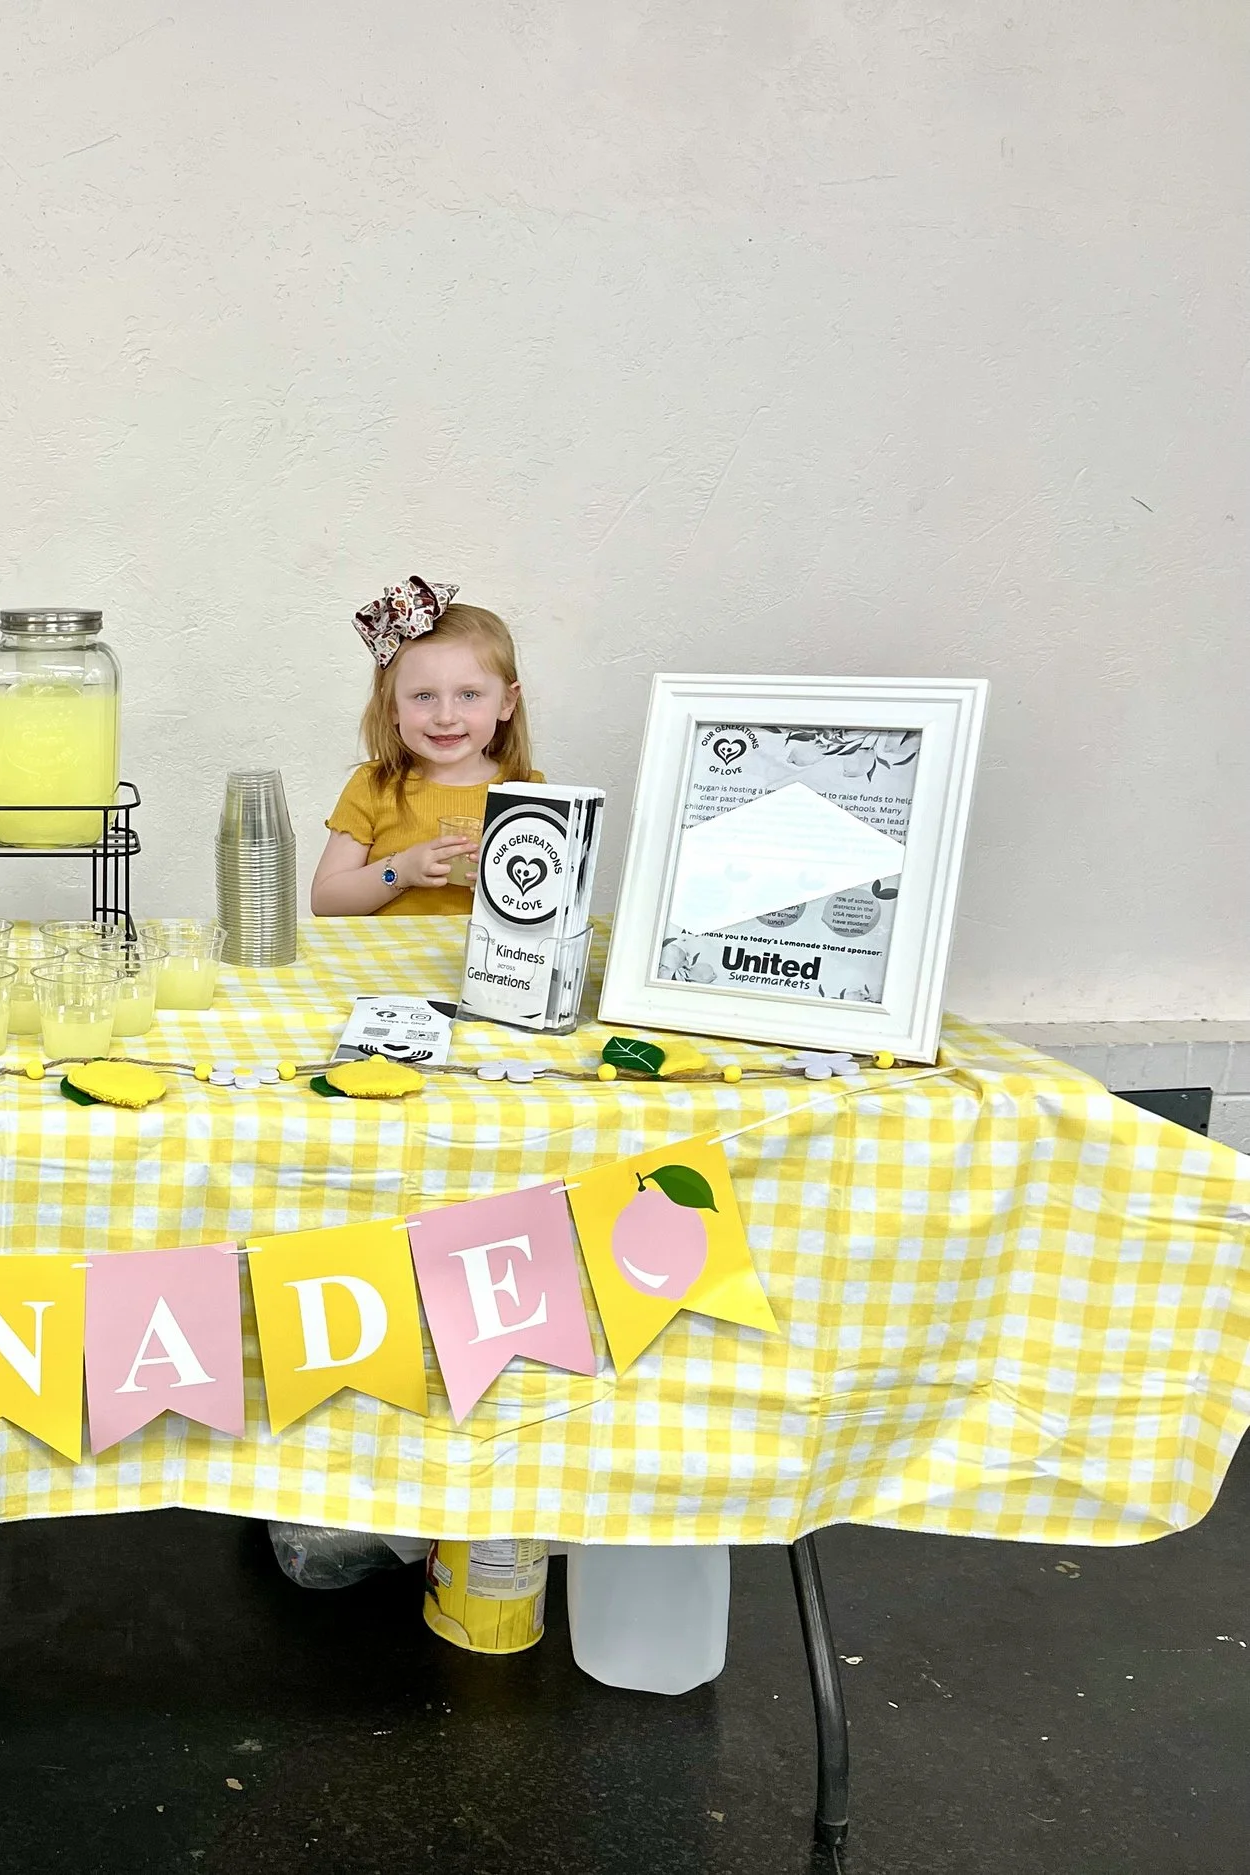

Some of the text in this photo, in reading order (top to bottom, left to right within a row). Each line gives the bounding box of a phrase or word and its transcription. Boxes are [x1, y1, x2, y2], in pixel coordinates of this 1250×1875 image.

[701, 724, 760, 750] OUR GENERATIONS
[709, 765, 743, 776] OF LOVE
[693, 783, 720, 792] Raygan
[729, 786, 757, 795] hosting
[828, 792, 837, 800] to
[859, 794, 883, 803] funds
[884, 796, 894, 804] to
[895, 797, 913, 806] help
[700, 793, 718, 801] clear
[879, 806, 903, 816] Many
[684, 803, 715, 812] children
[870, 816, 886, 824] can
[886, 816, 905, 826] lead
[889, 828, 907, 837] that
[493, 834, 563, 875] OUR GENERATIONS
[501, 894, 543, 911] OF LOVE
[724, 932, 739, 941] you
[750, 935, 778, 945] today's
[779, 938, 821, 950] Lemonade
[822, 943, 846, 953] Stand
[496, 944, 546, 965] Kindness
[721, 945, 822, 981] United
[467, 966, 531, 991] Generations
[496, 963, 516, 972] across
[728, 971, 810, 990] Supermarkets
